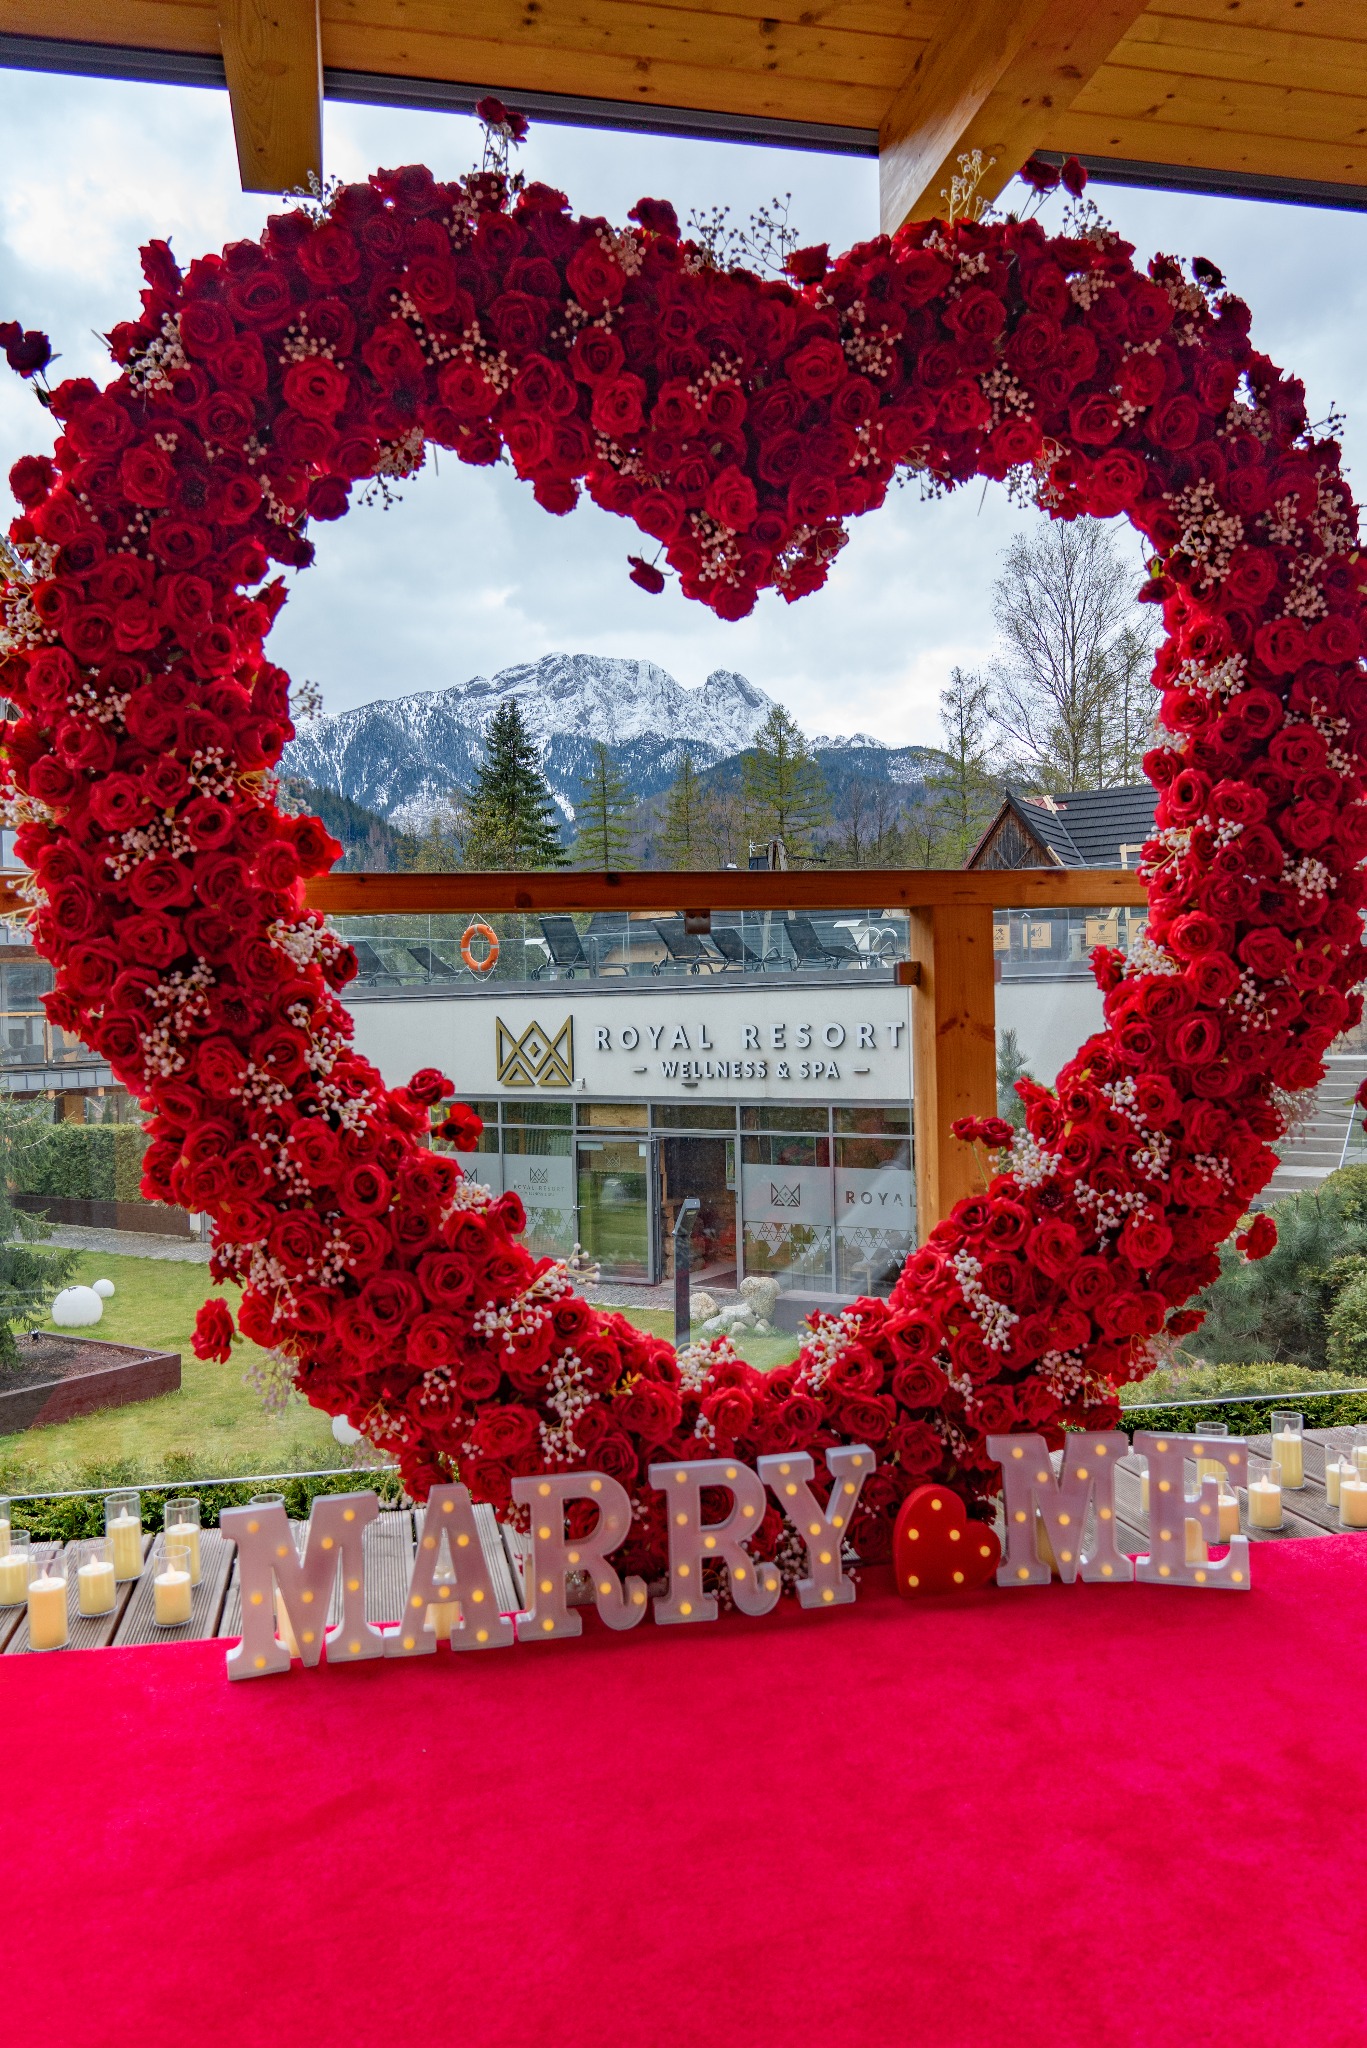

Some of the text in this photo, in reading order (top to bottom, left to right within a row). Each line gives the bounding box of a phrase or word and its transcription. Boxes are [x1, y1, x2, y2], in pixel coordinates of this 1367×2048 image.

[593, 1021, 905, 1050] ROYAL RESORT
[661, 1060, 841, 1079] WELLNESS & SPA
[845, 1190, 917, 1208] ROYAL
[220, 1431, 1251, 1681] MARRY ME
